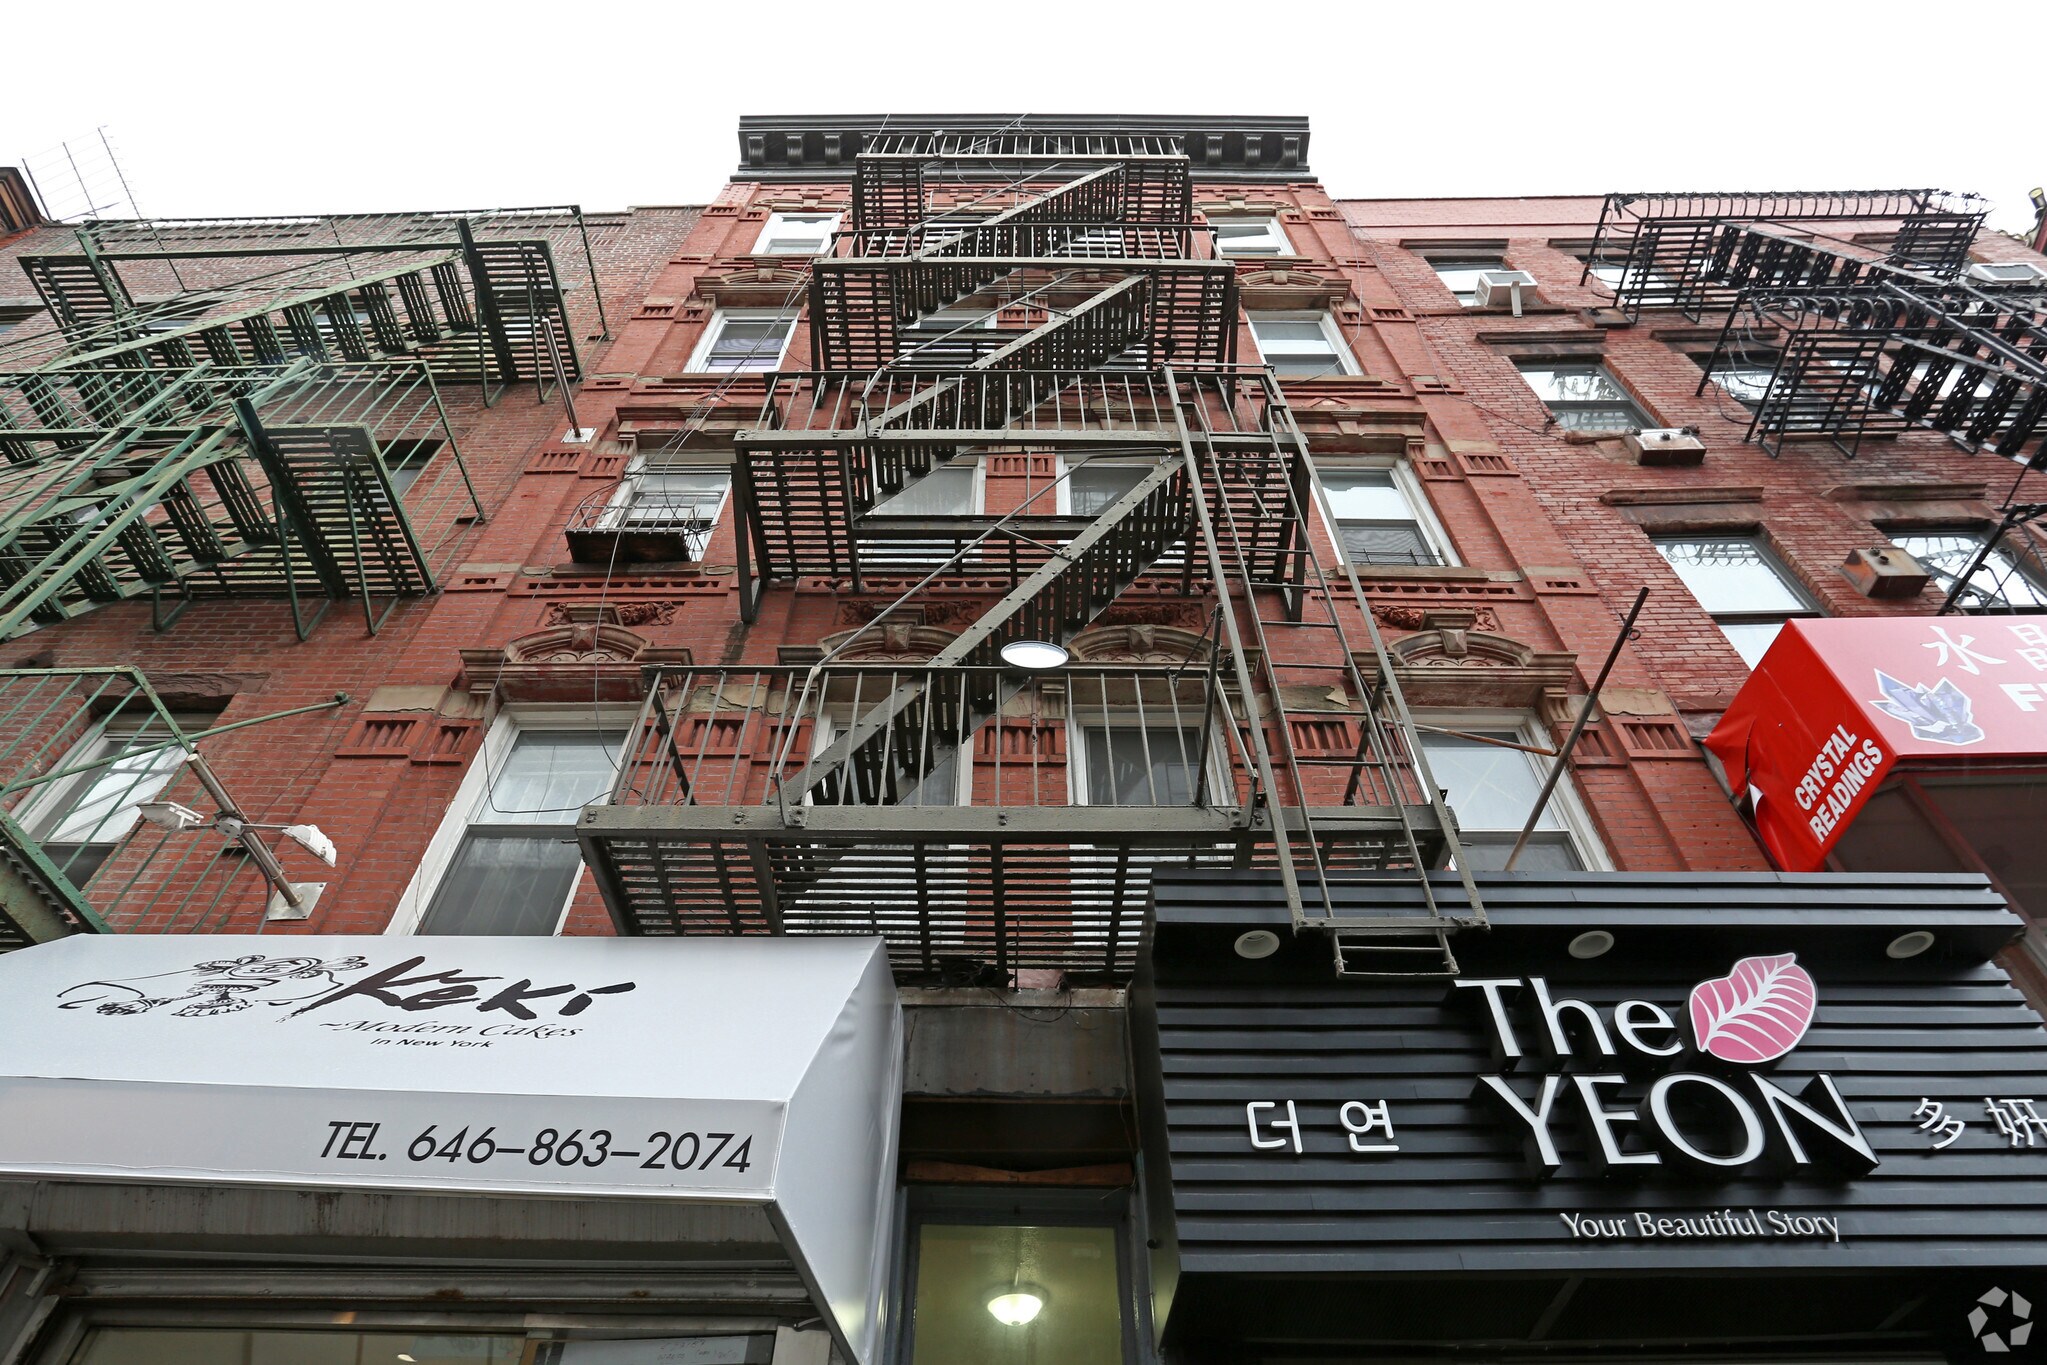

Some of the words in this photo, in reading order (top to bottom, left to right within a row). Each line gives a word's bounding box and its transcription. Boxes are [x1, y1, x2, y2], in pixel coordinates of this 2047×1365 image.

[1795, 724, 1857, 811] CRYSTAL
[1809, 739, 1882, 843] READINGS
[396, 1039, 444, 1048] New
[450, 1040, 494, 1048] York
[479, 1023, 583, 1040] Cakes
[1454, 976, 1685, 1058] The
[320, 1120, 387, 1161] TEL.
[407, 1124, 754, 1173] 646-863-2074
[1481, 1072, 1880, 1167] YEON
[1560, 1212, 1627, 1238] Your
[1634, 1208, 1764, 1237] Beautiful
[1767, 1210, 1840, 1243] Story
